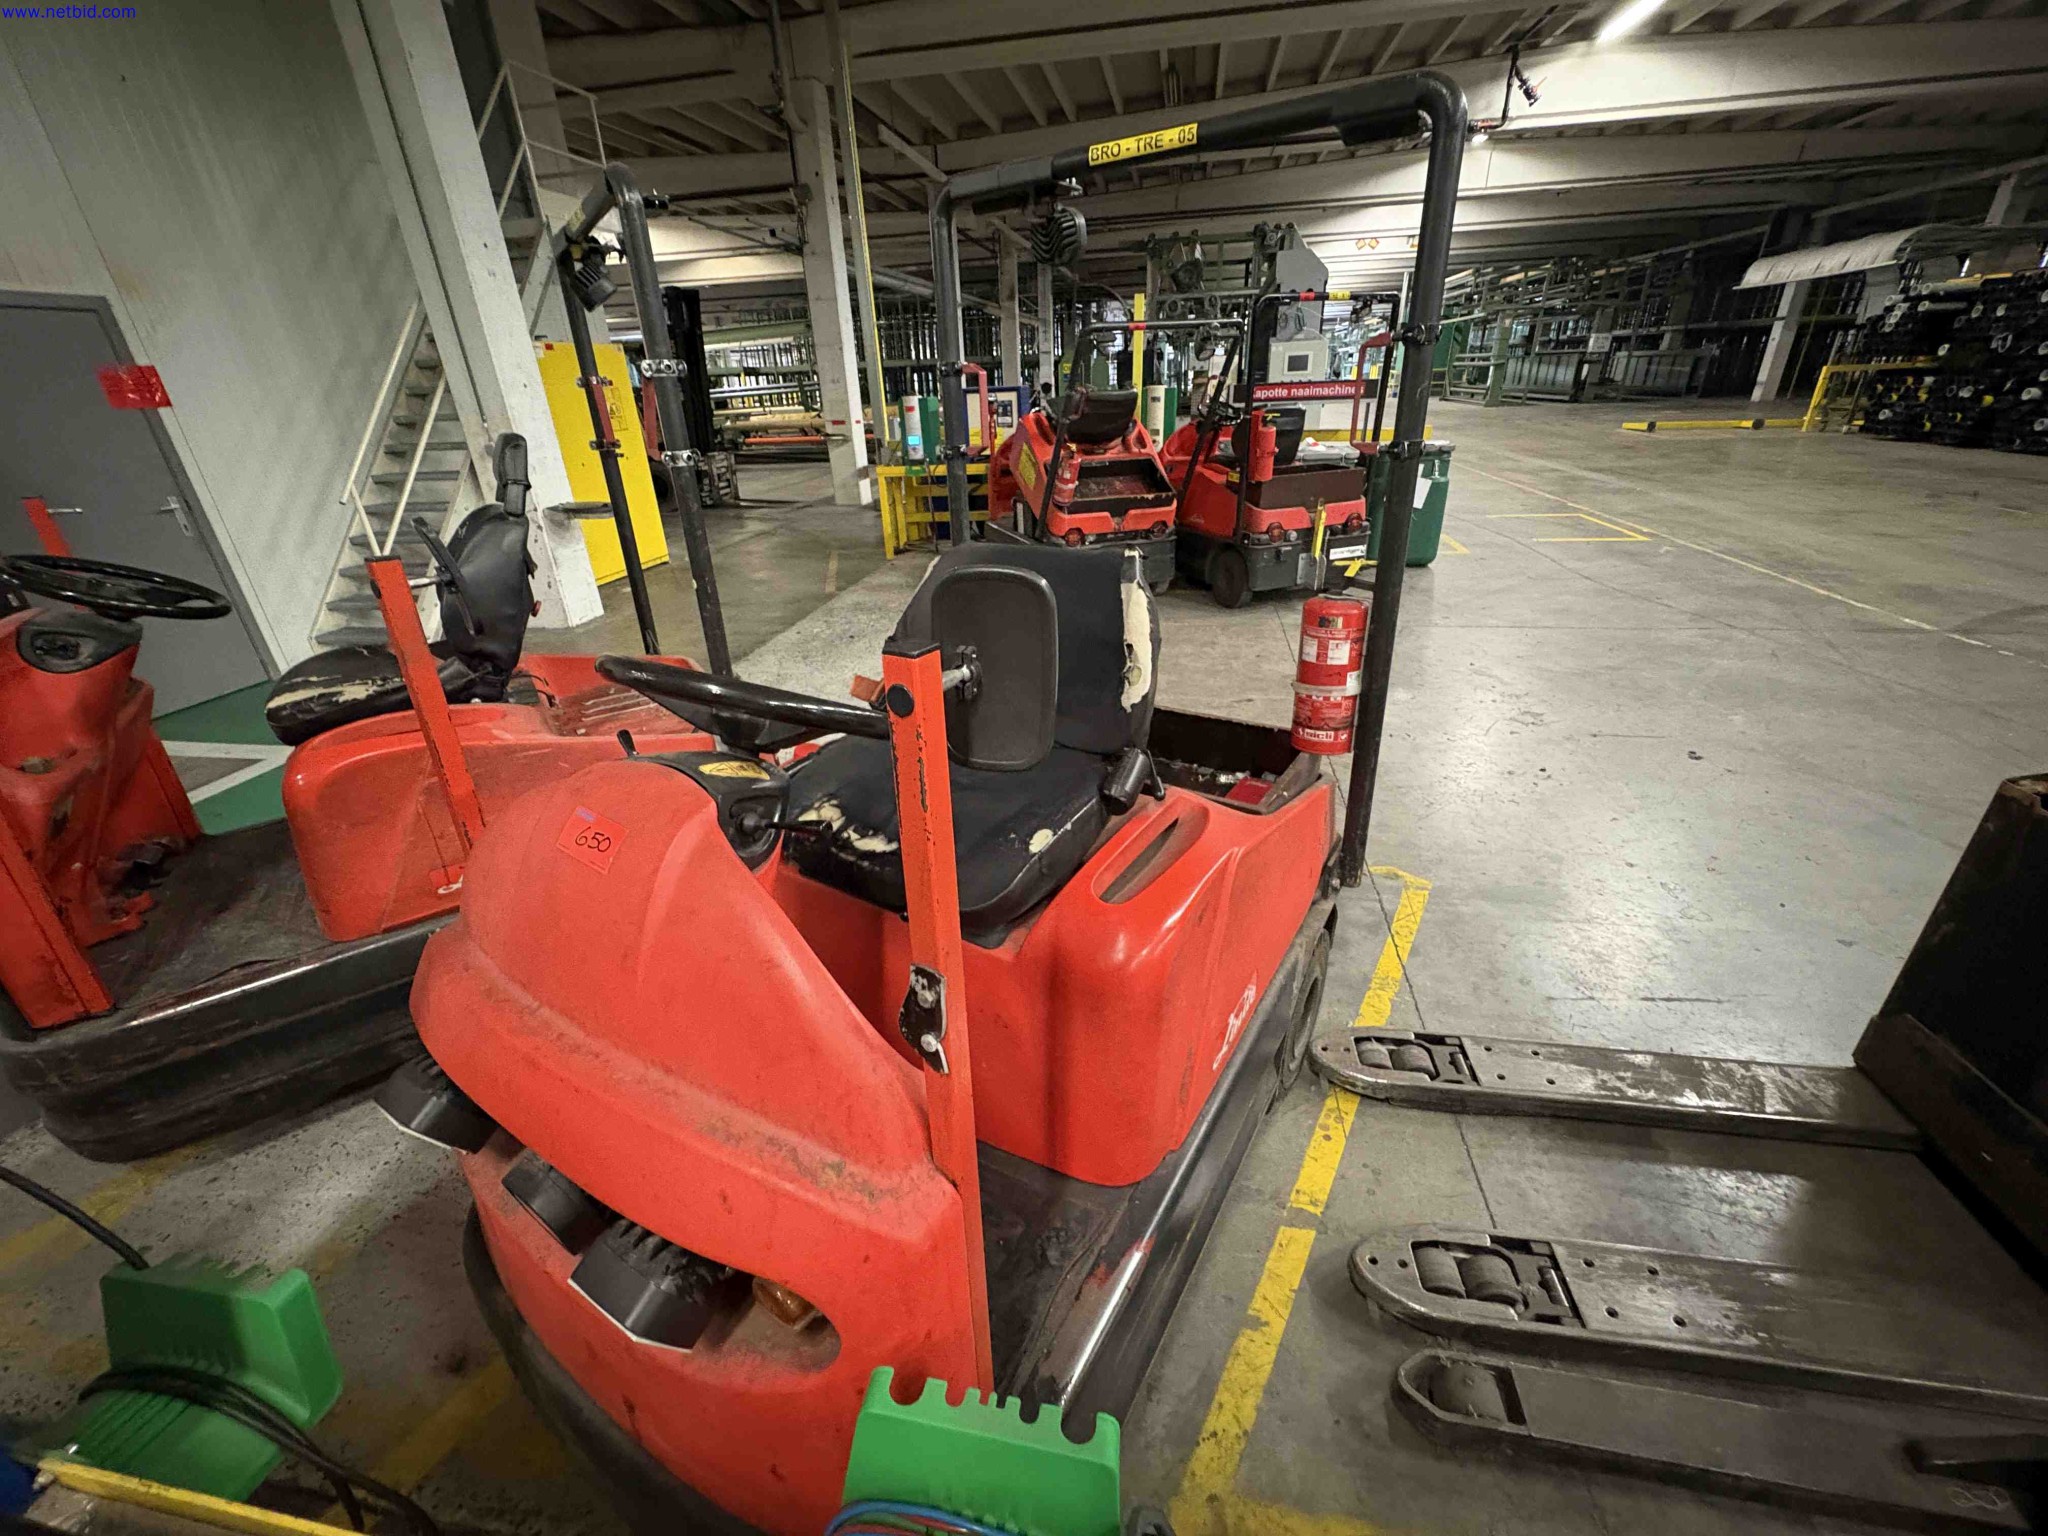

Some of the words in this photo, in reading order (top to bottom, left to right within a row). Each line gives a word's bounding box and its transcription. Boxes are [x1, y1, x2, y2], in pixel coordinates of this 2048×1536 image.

[1090, 142, 1121, 162] BRO
[1134, 133, 1164, 153] TRE
[1177, 126, 1195, 144] 05
[575, 826, 611, 853] 650
